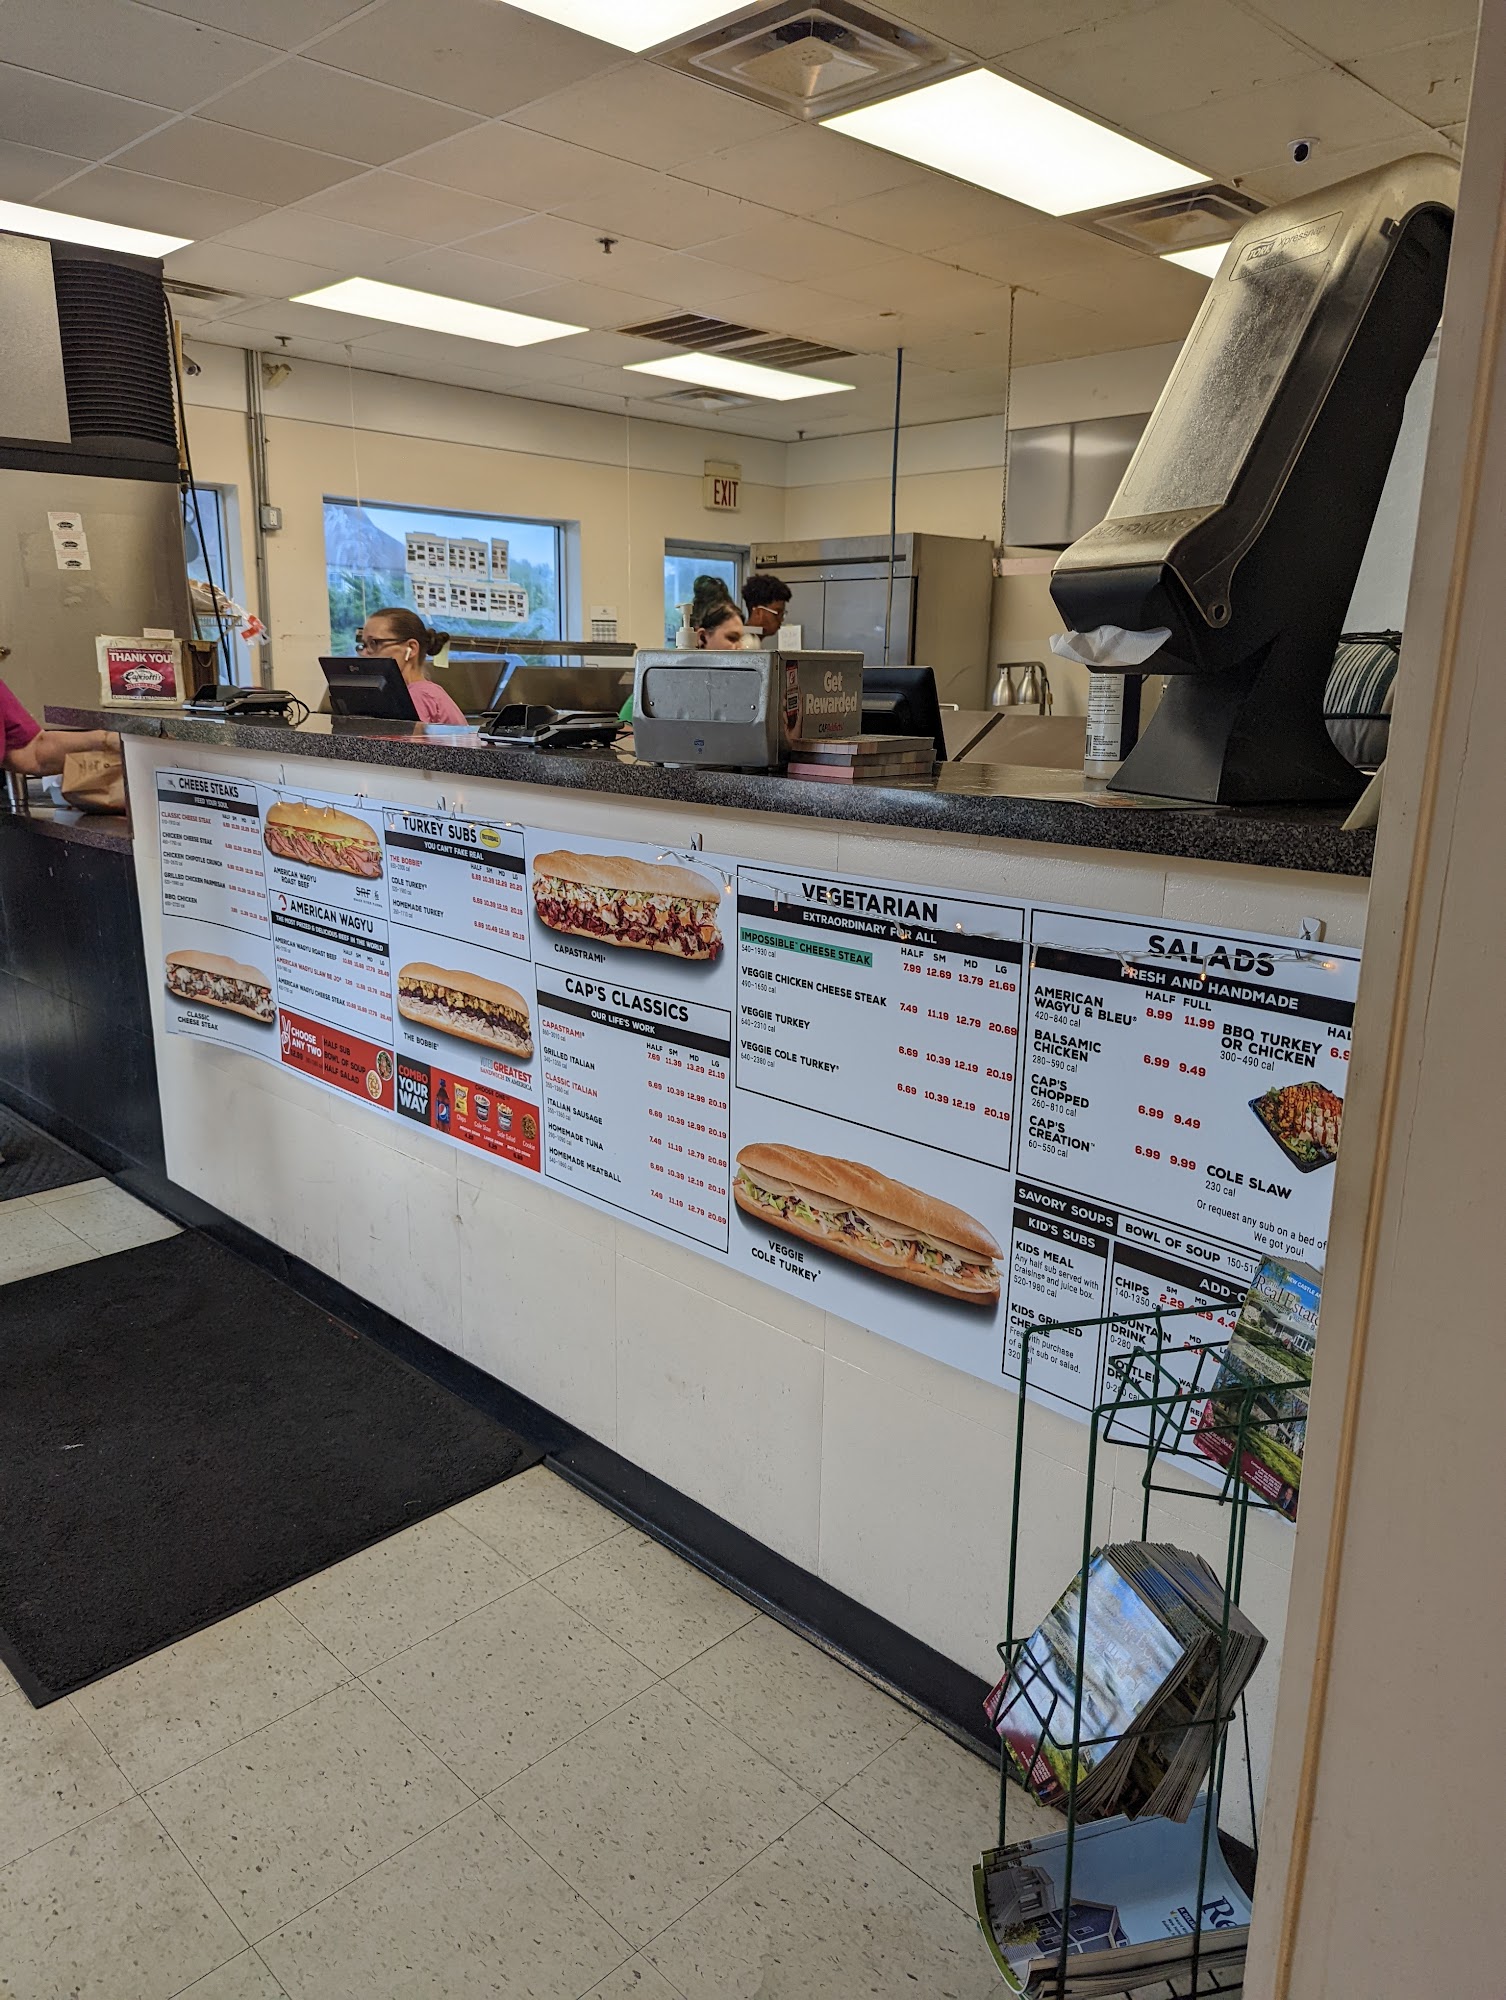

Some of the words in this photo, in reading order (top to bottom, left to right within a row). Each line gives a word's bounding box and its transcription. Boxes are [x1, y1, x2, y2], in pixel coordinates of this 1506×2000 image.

[714, 479, 738, 507] EXIT
[109, 653, 147, 662] THANK
[149, 654, 174, 663] YOU!
[824, 671, 842, 692] Get
[806, 691, 857, 716] Rewarded
[179, 778, 209, 792] CHEESE
[211, 785, 239, 798] STEAKS
[161, 812, 181, 820] CLASSIC
[182, 814, 197, 822] CHEESE
[162, 832, 183, 840] CHICKEN
[184, 835, 199, 843] CHEESE
[200, 837, 212, 845] STEAK
[403, 817, 444, 836] TURKEY
[449, 825, 476, 843] SUBS
[424, 842, 436, 850] YOU
[436, 844, 453, 854] CAN'T
[454, 847, 468, 856] FAKE
[469, 851, 484, 860] REAL
[273, 867, 295, 878] AMERICAN
[296, 873, 316, 882] WAGYU
[281, 876, 296, 886] ROAST
[298, 881, 309, 889] BEEF
[165, 893, 175, 901] BBQ
[177, 896, 197, 904] CHICKEN
[393, 899, 422, 912] HOMEMADE
[424, 906, 444, 918] TURKEY
[801, 883, 938, 922] VEGETARIAN
[291, 900, 337, 924] AMERICAN
[340, 912, 373, 933] WAGYU
[803, 912, 886, 935] EXTRAORDINARY
[890, 927, 912, 939] FOR
[916, 931, 937, 944] ALL
[275, 937, 295, 947] AMERICAN
[296, 943, 311, 952] WAGYU
[312, 946, 326, 956] ROAST
[327, 950, 337, 960] BEEF
[1148, 934, 1275, 977] SALADS
[901, 947, 924, 958] HALF
[933, 953, 946, 963] SM
[964, 958, 977, 969] MD
[996, 964, 1007, 974] LG
[742, 966, 772, 980] VEGGIE
[775, 974, 813, 990] CHICKEN
[816, 983, 852, 999] CHEESE
[854, 992, 887, 1007] STEAK
[903, 963, 921, 973] 7.99
[926, 968, 951, 979] 12.69
[958, 973, 984, 986] 13.79
[989, 980, 1015, 992] 21.69
[1121, 967, 1166, 984] FRESH
[1171, 976, 1204, 991] AND
[1208, 982, 1299, 1010] HANDMADE
[565, 978, 606, 1002] CAP'S
[612, 990, 689, 1022] CLASSICS
[1034, 996, 1080, 1017] WAGYU
[1084, 1006, 1093, 1017] &
[1035, 986, 1103, 1008] AMERICAN
[1145, 990, 1176, 1005] HALF
[1183, 997, 1212, 1012] FULL
[178, 1017, 199, 1027] CHEESE
[187, 1011, 209, 1021] CLASSIC
[201, 1021, 218, 1030] STEAK
[591, 1010, 607, 1021] OUR
[608, 1015, 631, 1028] LIFE'S
[632, 1022, 656, 1035] WORK
[1146, 1008, 1173, 1021] 8.99
[1184, 1016, 1215, 1030] 11.99
[291, 1027, 316, 1045] CHOOSE
[292, 1039, 306, 1051] ANY
[1034, 1029, 1102, 1053] BALSAMIC
[1222, 1024, 1254, 1042] BBQ
[1261, 1032, 1323, 1055] TURKEY
[1327, 1027, 1352, 1041] HAL
[307, 1044, 322, 1057] TWO
[324, 1039, 338, 1050] HALF
[339, 1045, 351, 1055] SUB
[544, 1046, 568, 1060] GRILLED
[570, 1055, 595, 1070] ITALIAN
[741, 1040, 772, 1056] VEGGIE
[775, 1049, 797, 1062] COLE
[1033, 1041, 1088, 1062] CHICKEN
[1221, 1037, 1242, 1051] OR
[1248, 1042, 1316, 1068] CHICKEN
[1330, 1047, 1349, 1061] 6.9
[324, 1051, 339, 1064] BOWL
[341, 1057, 348, 1066] OF
[350, 1061, 366, 1073] SOUP
[1143, 1055, 1170, 1068] 6.99
[1179, 1063, 1206, 1077] 9.49
[324, 1064, 339, 1076] HALF
[340, 1069, 359, 1083] SALAD
[398, 1064, 428, 1083] COMBO
[480, 1067, 504, 1080] SANDWICH
[511, 1077, 533, 1091] AMERICA
[494, 1062, 531, 1085] GREATEST
[398, 1076, 428, 1099] YOUR
[399, 1089, 428, 1115] WAY
[547, 1097, 571, 1113] ITALIAN
[573, 1108, 602, 1125] SAUSAGE
[457, 1115, 466, 1123] Chips
[1029, 1115, 1065, 1133] CAP'S
[549, 1122, 583, 1142] HOMEMADE
[586, 1137, 604, 1151] TUNA
[1135, 1146, 1161, 1160] 6.99
[1169, 1156, 1197, 1171] 9.99
[1205, 1180, 1221, 1193] 230
[1223, 1186, 1236, 1197] cal
[1206, 1165, 1243, 1184] COLE
[1249, 1178, 1292, 1200] SLAW
[1019, 1189, 1067, 1211] SAVORY
[1071, 1205, 1114, 1227] SOUPS
[1029, 1218, 1058, 1235] KID'S
[1063, 1230, 1096, 1248] SUBS
[1197, 1199, 1206, 1209] Or
[1208, 1202, 1239, 1222] request
[1242, 1215, 1257, 1228] any
[1259, 1220, 1274, 1233] sub
[1277, 1227, 1288, 1236] on
[1298, 1232, 1314, 1245] bed
[1125, 1223, 1160, 1243] BOWL
[1165, 1237, 1181, 1249] OF
[1186, 1244, 1221, 1263] SOUP
[1253, 1232, 1267, 1244] We
[1269, 1238, 1284, 1253] got
[1286, 1243, 1304, 1257] you!
[1115, 1277, 1149, 1296] CHIPS
[1115, 1288, 1150, 1307] 140-1350
[1166, 1286, 1178, 1294] SM
[1195, 1297, 1207, 1305] MD
[1255, 1275, 1284, 1303] Real
[1298, 1281, 1315, 1294] CASTLE
[1160, 1294, 1185, 1309] 2.29
